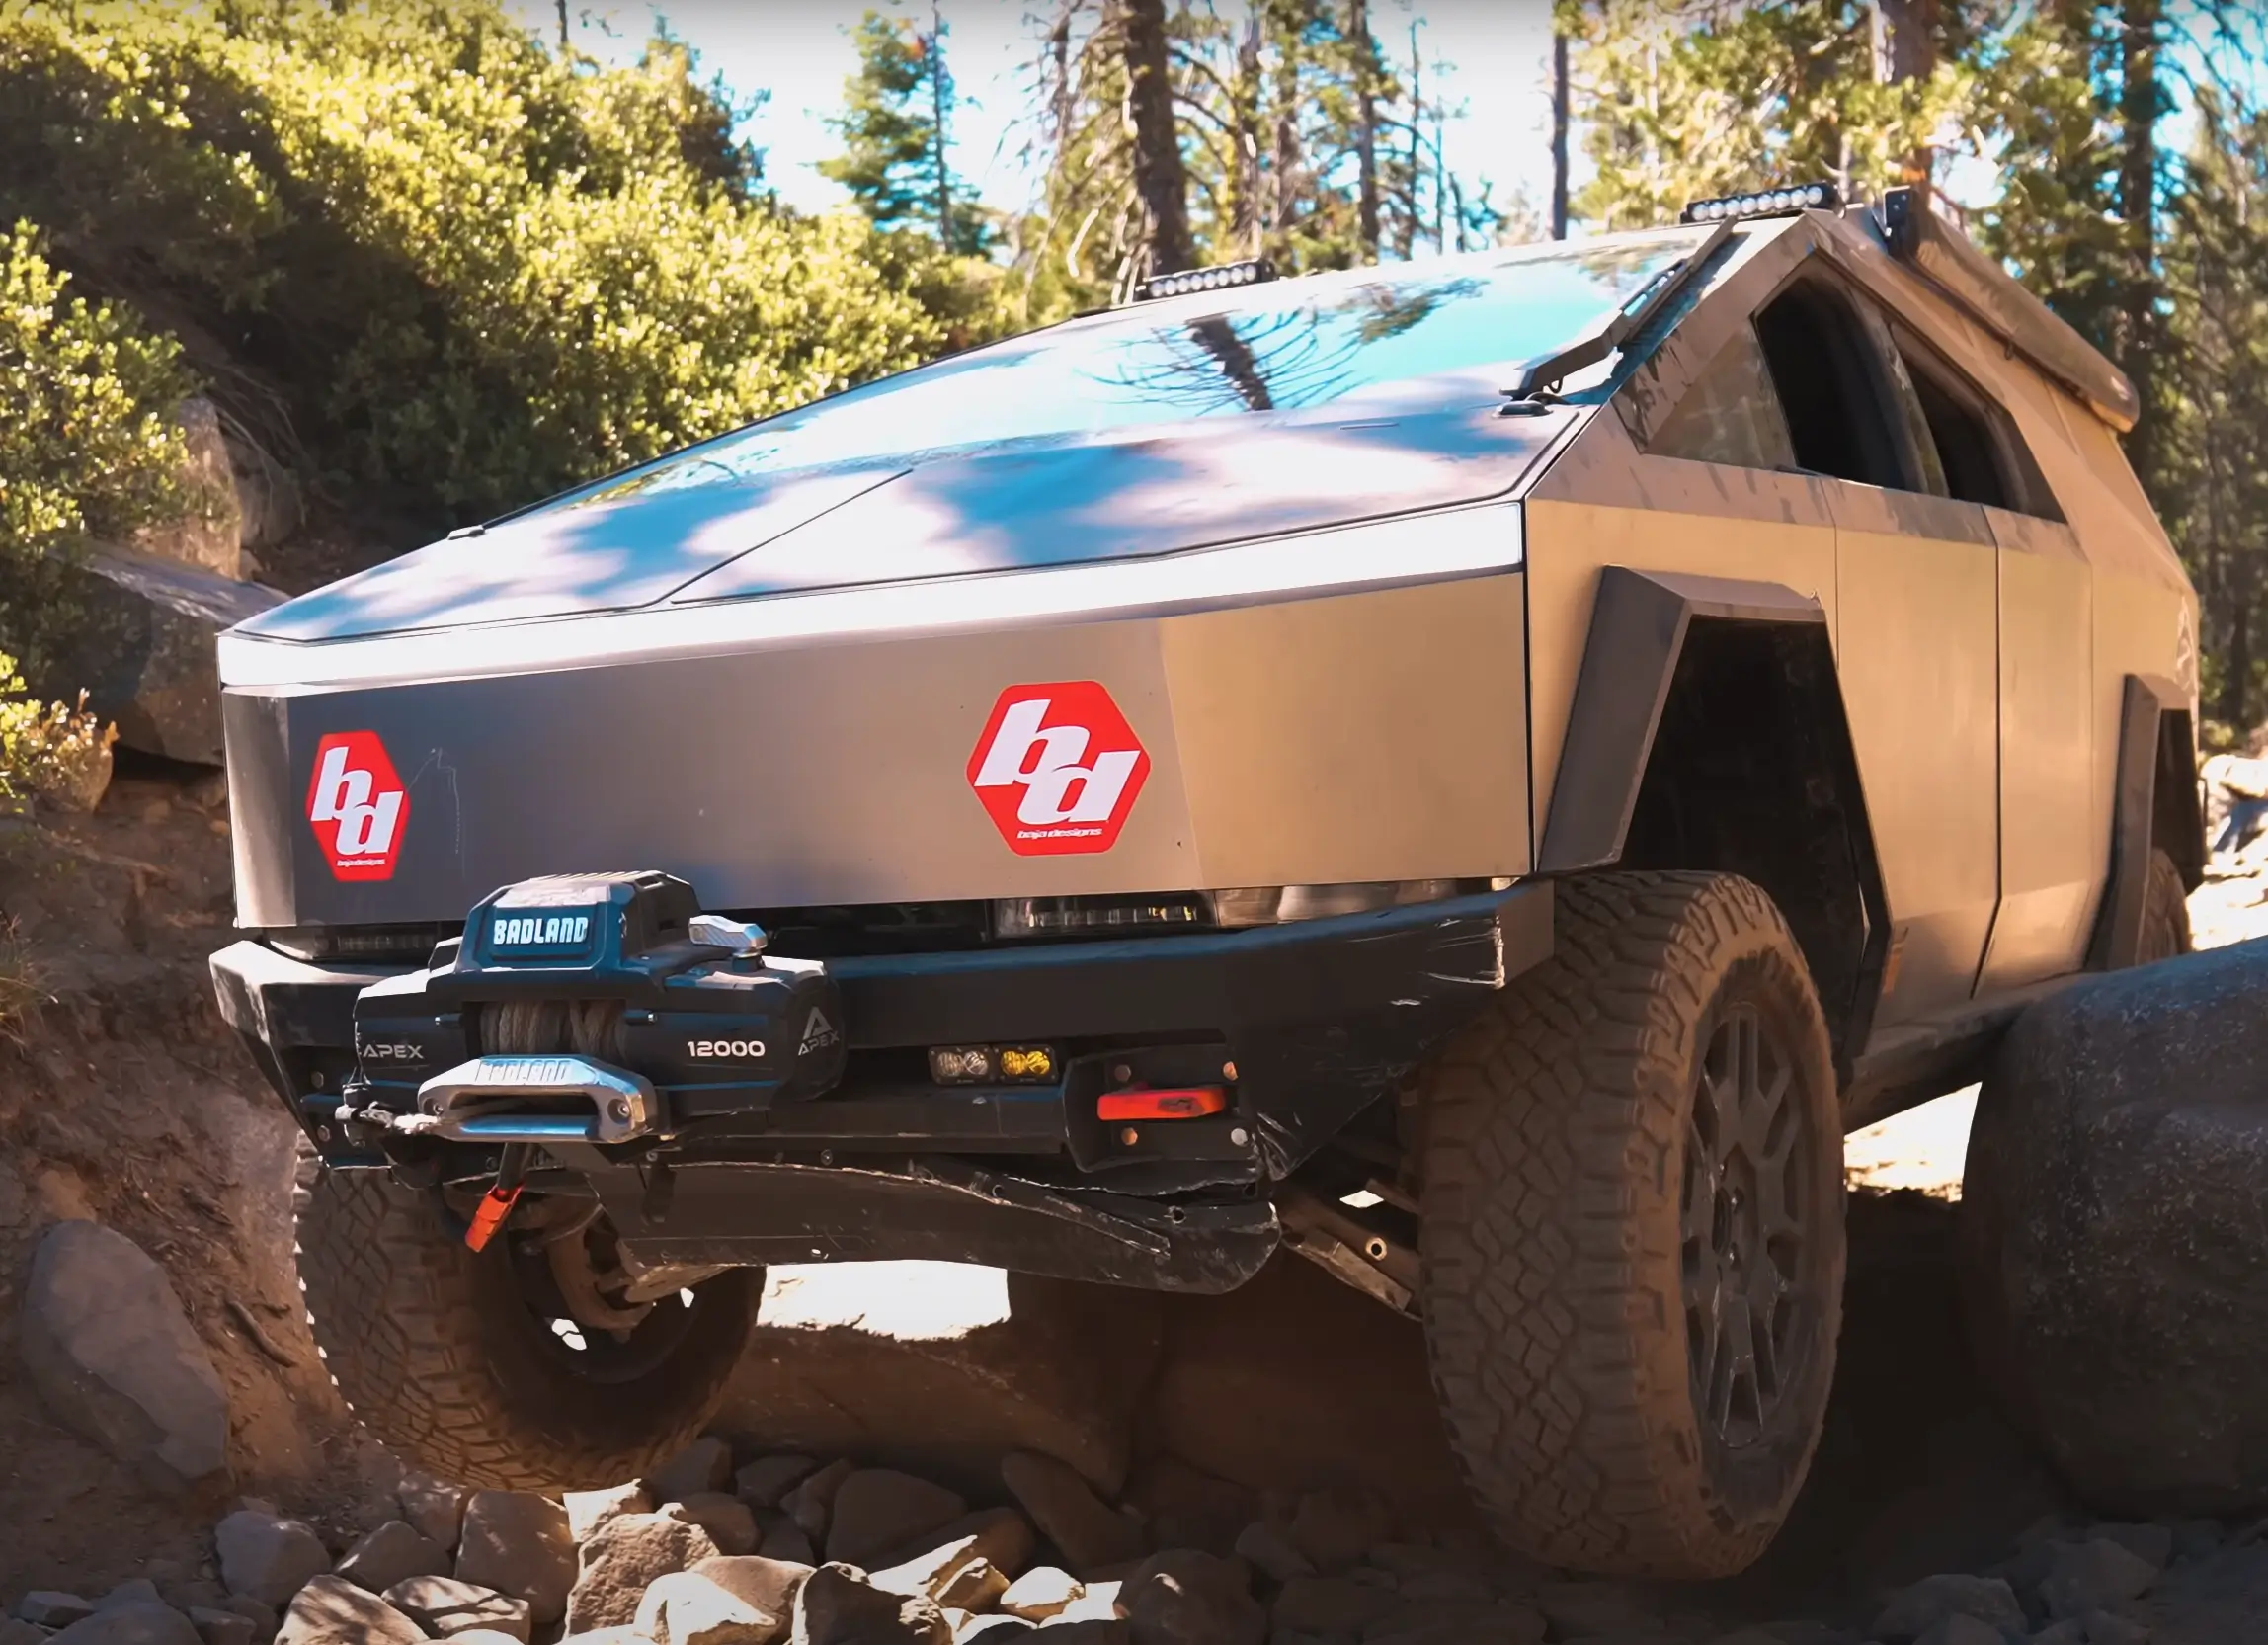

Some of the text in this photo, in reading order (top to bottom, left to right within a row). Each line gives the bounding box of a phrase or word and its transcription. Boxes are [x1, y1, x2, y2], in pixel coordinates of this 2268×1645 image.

[973, 698, 1141, 825] bd
[310, 745, 404, 856] bd
[493, 917, 589, 945] BADLAND
[362, 1043, 424, 1059] APEX
[688, 1040, 766, 1057] 12000
[797, 1030, 840, 1056] APEX
